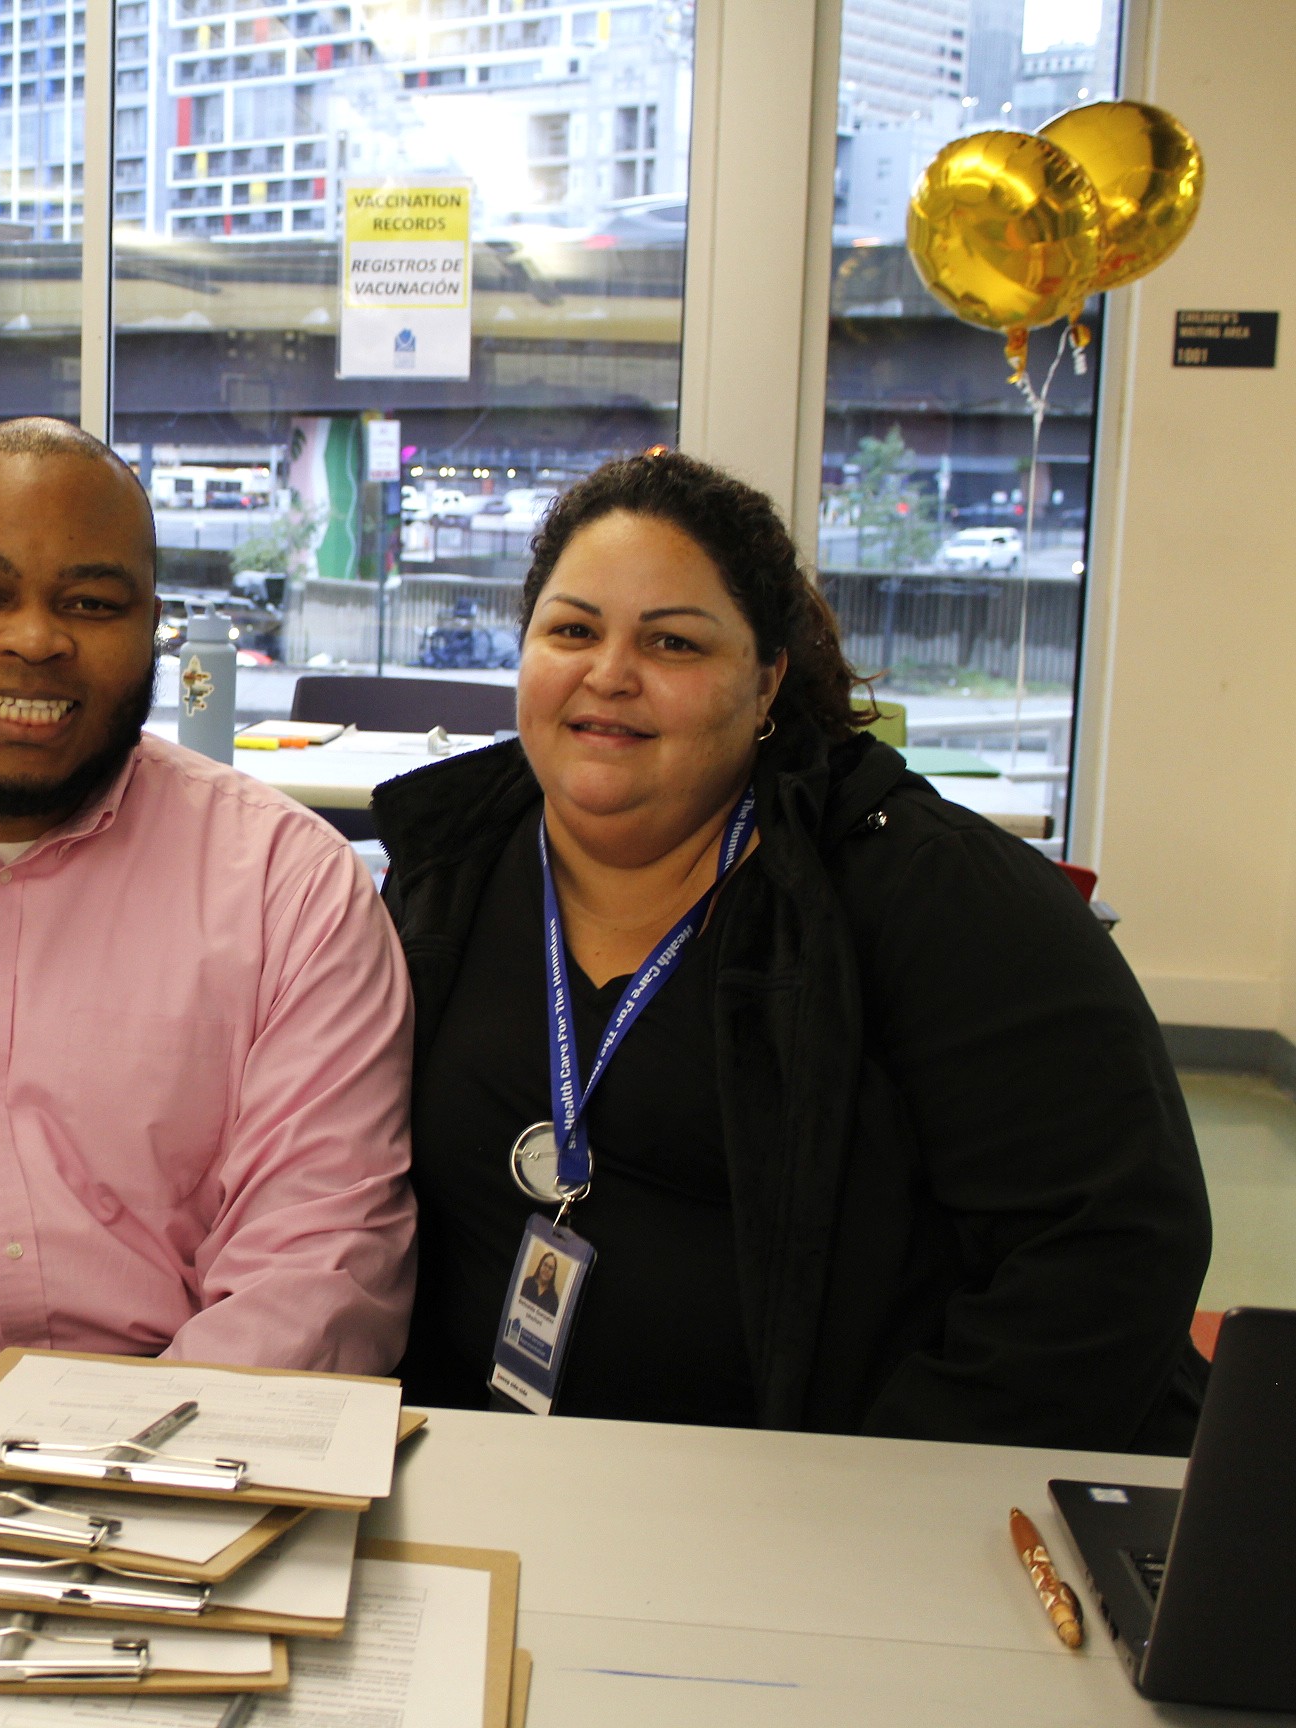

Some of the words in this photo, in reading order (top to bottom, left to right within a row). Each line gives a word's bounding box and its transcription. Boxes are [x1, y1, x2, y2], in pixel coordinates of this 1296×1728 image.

[354, 194, 461, 208] VACCINATION
[373, 217, 446, 231] RECORDS
[351, 259, 436, 273] REGISTROS
[442, 259, 463, 272] DE
[354, 279, 460, 295] VACUNACIÓN
[656, 924, 694, 967] Health
[631, 965, 661, 999] Care
[554, 988, 565, 1015] The
[615, 999, 636, 1029] For
[557, 1015, 568, 1042] For
[599, 1029, 619, 1058] The
[559, 1043, 572, 1079] Care
[560, 1080, 576, 1130] Health
